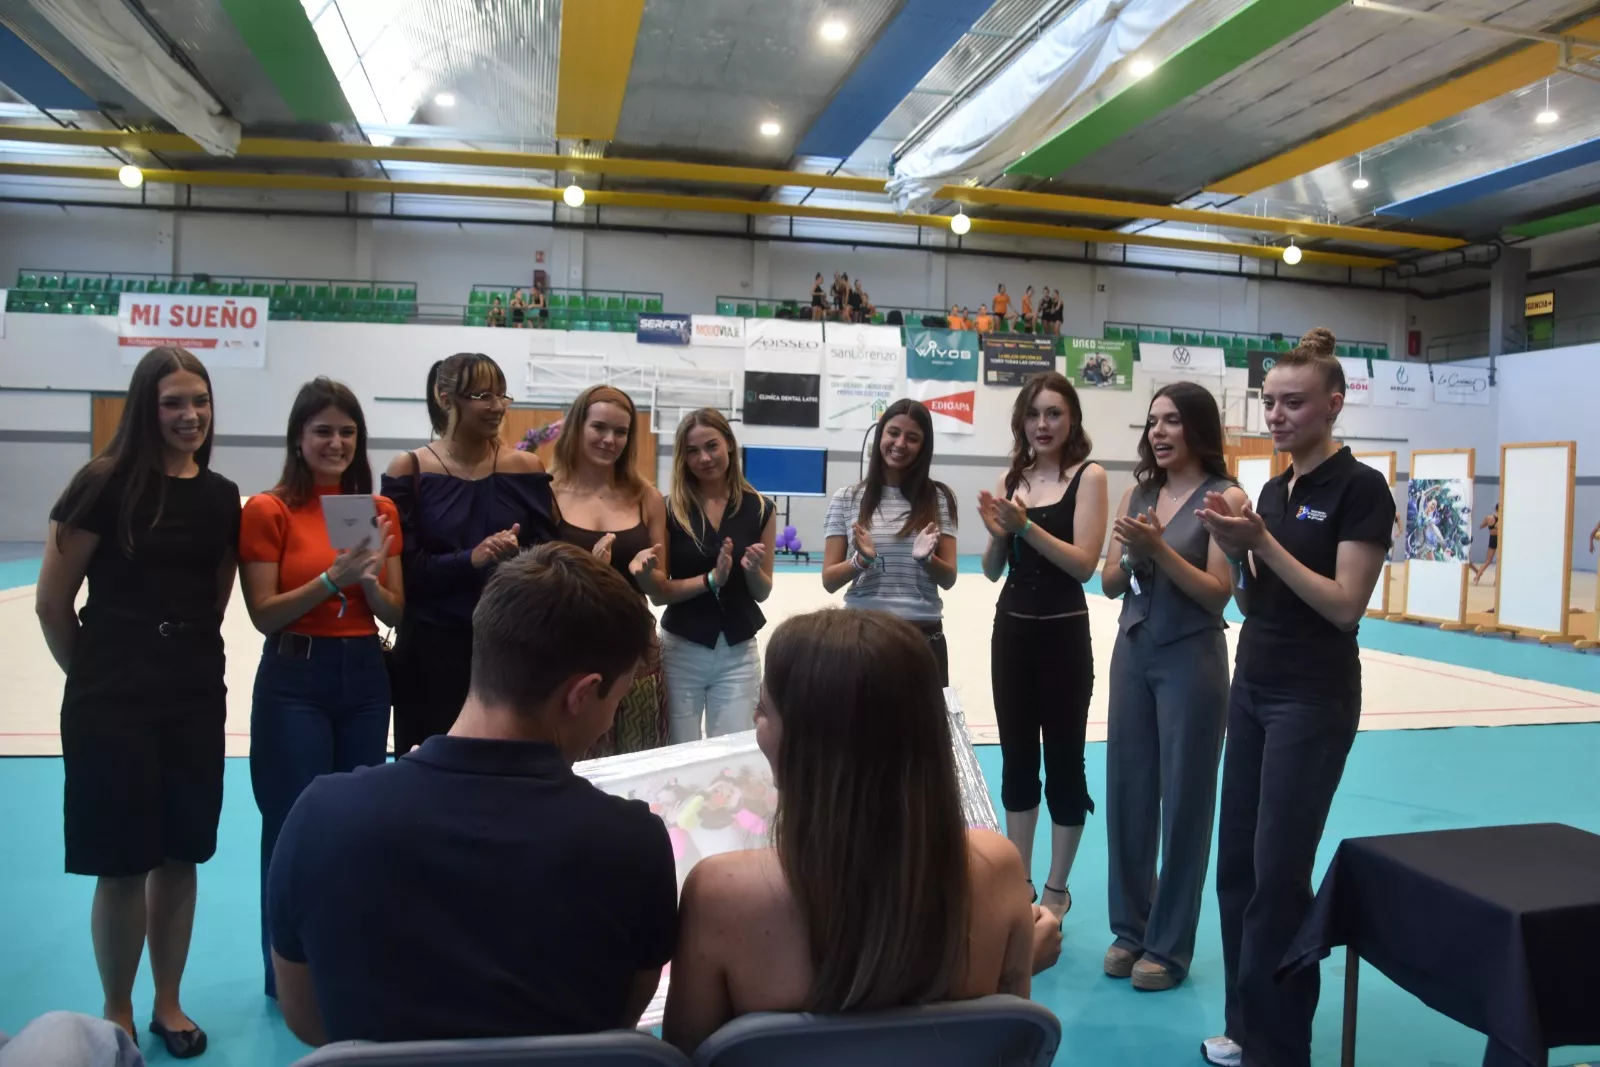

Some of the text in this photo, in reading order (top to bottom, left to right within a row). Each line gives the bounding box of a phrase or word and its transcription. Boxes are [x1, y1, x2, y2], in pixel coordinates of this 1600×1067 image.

[130, 300, 257, 329] MI SUEÑO
[640, 319, 687, 329] SERFEY
